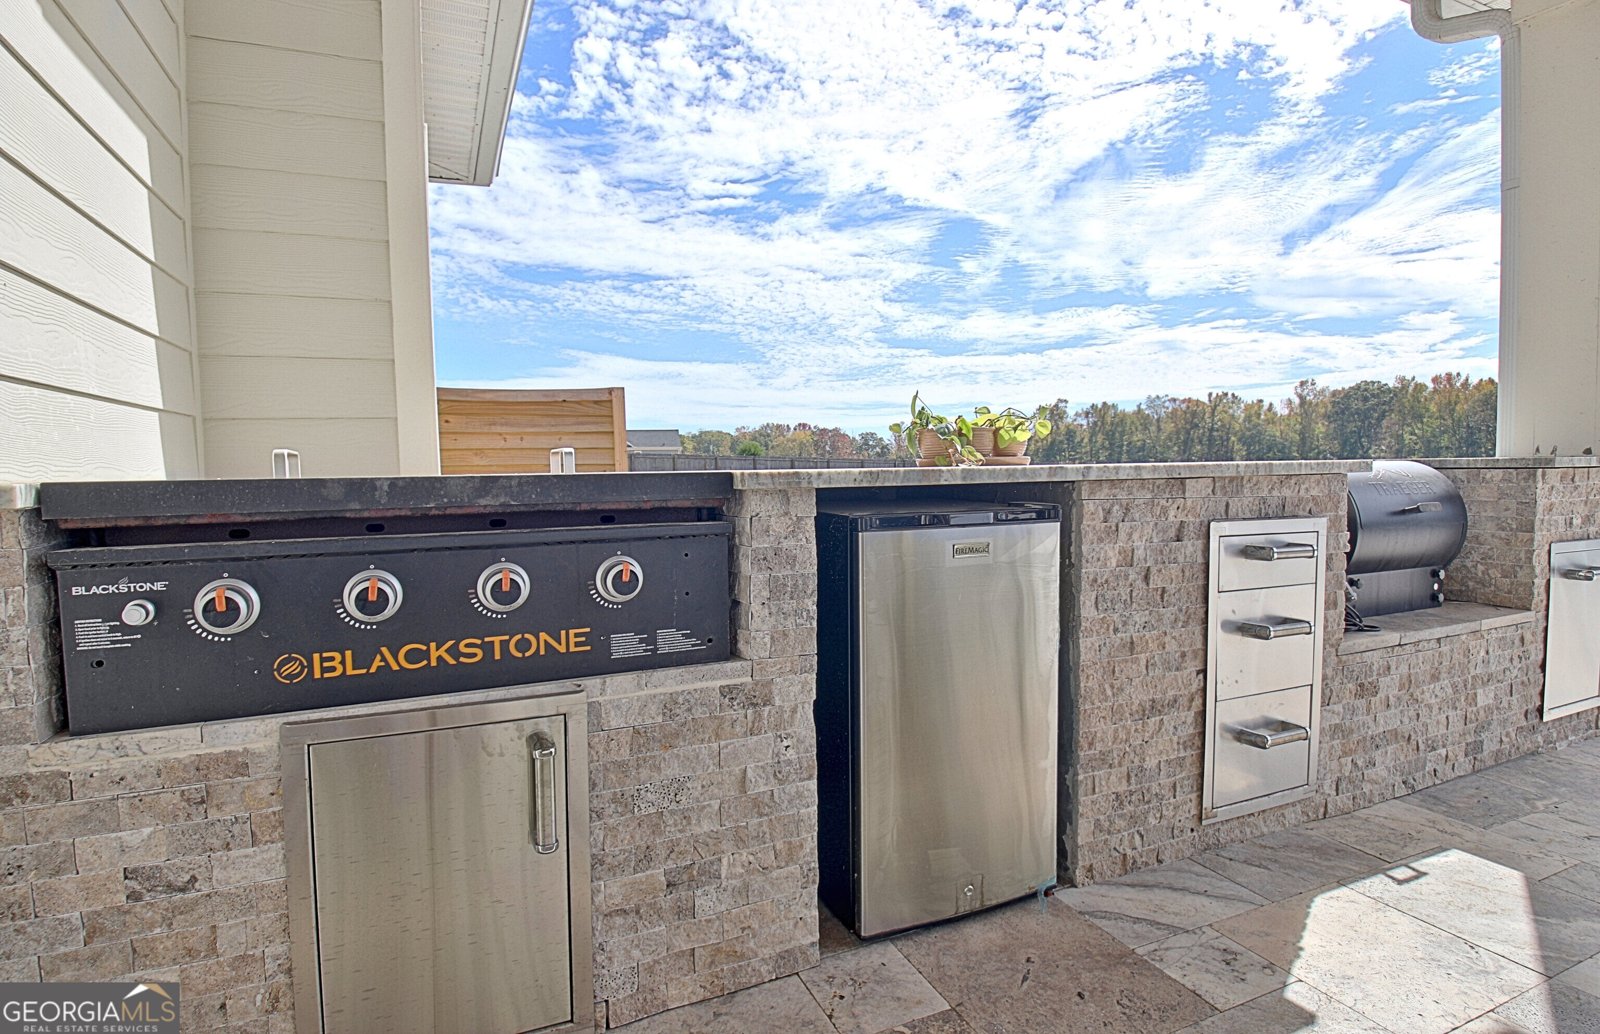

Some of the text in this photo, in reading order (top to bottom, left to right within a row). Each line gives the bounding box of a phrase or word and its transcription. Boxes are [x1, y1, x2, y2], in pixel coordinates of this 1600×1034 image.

[1368, 481, 1437, 496] TRAEGER
[71, 581, 168, 596] BLACKSTONE
[312, 627, 592, 679] BLACKSTONE
